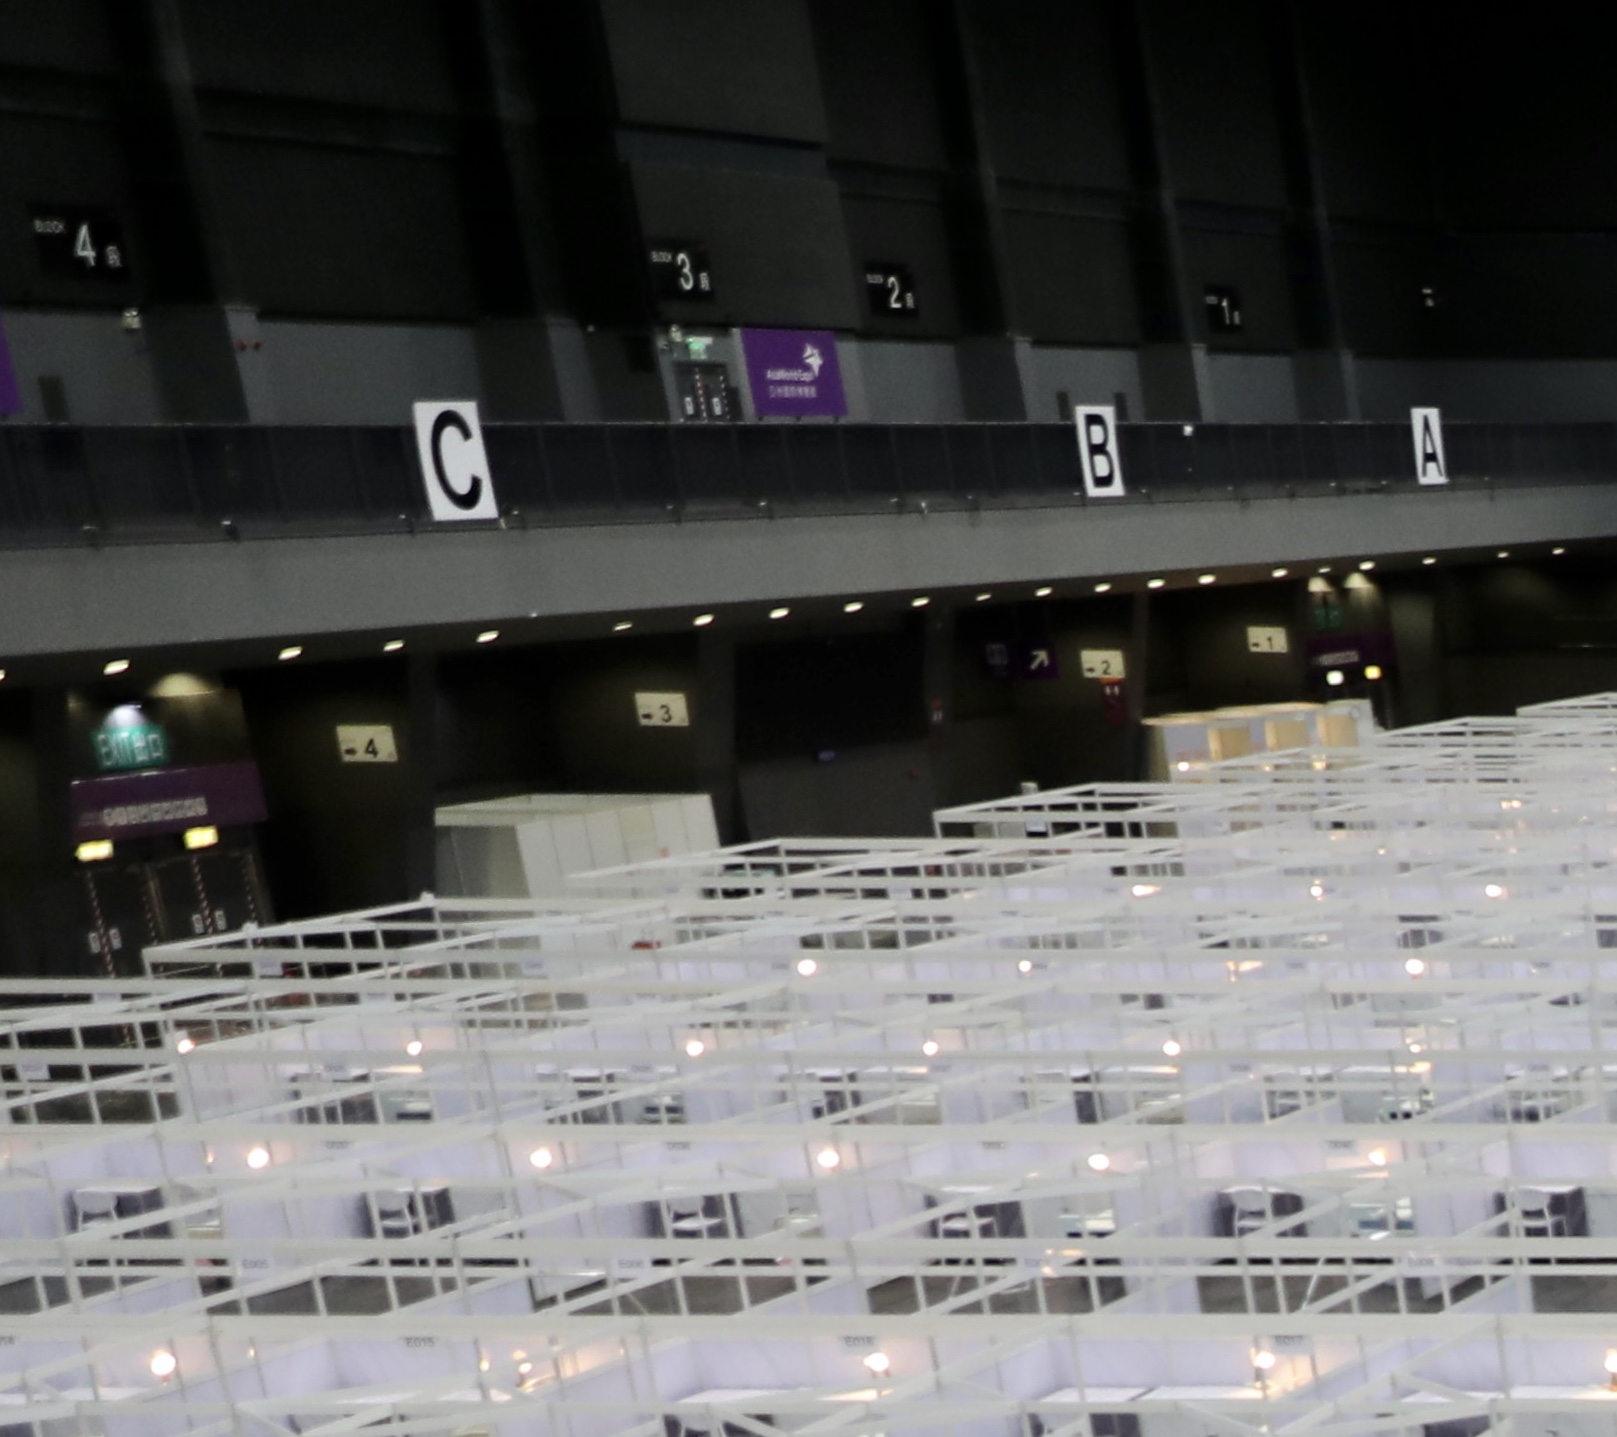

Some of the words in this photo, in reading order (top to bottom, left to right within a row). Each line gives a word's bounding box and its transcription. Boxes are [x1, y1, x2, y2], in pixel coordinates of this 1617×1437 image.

[75, 224, 96, 267] 4
[651, 251, 673, 263] BLOCK
[676, 252, 694, 290] 3
[887, 275, 902, 309] 2
[1221, 298, 1230, 325] 1
[431, 410, 482, 510] C
[1085, 413, 1113, 488] B
[1422, 414, 1443, 478] A
[1266, 637, 1274, 651] 1
[1101, 661, 1112, 676] 2
[659, 705, 672, 724] 3
[365, 738, 378, 758] 4
[405, 1337, 435, 1347] E015
